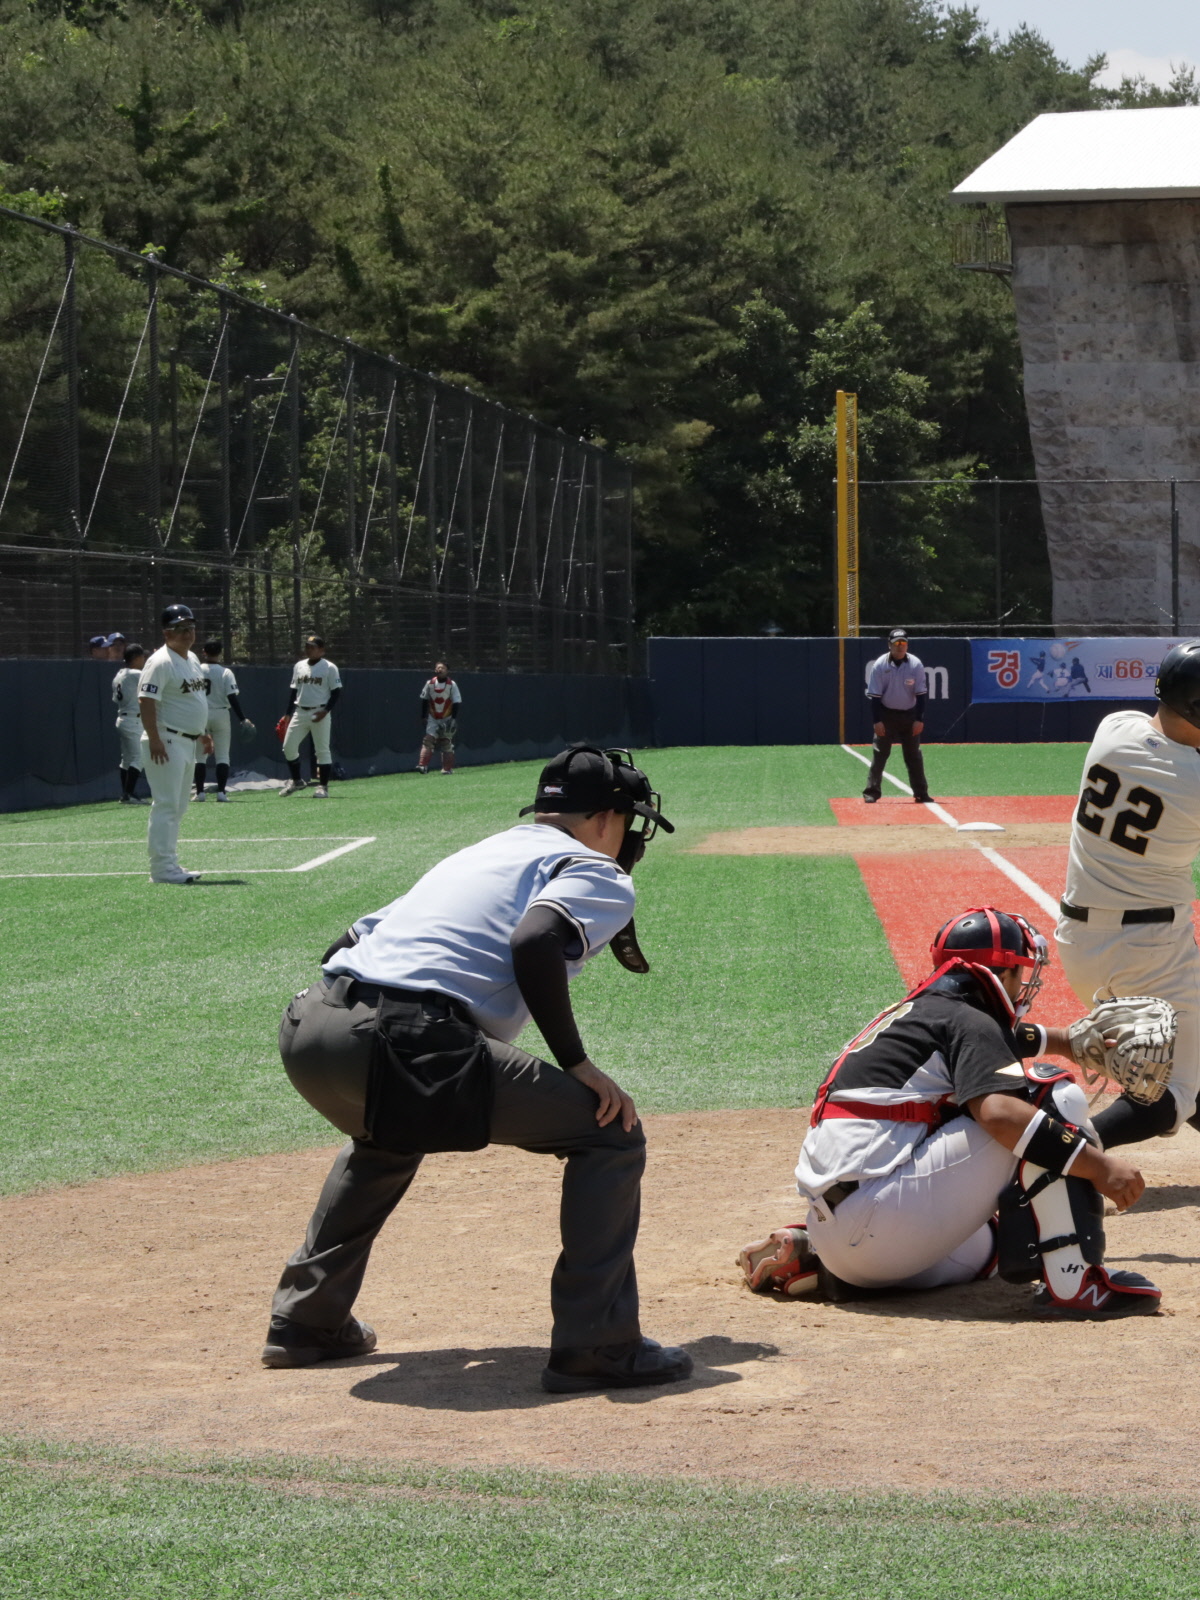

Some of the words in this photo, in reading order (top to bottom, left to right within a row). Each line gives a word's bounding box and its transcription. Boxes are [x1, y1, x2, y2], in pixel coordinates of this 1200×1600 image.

[989, 651, 1020, 688] 경
[1097, 660, 1158, 679] 제66회
[1077, 763, 1165, 857] 22
[1024, 1027, 1035, 1041] 10
[1061, 1130, 1075, 1143] 10
